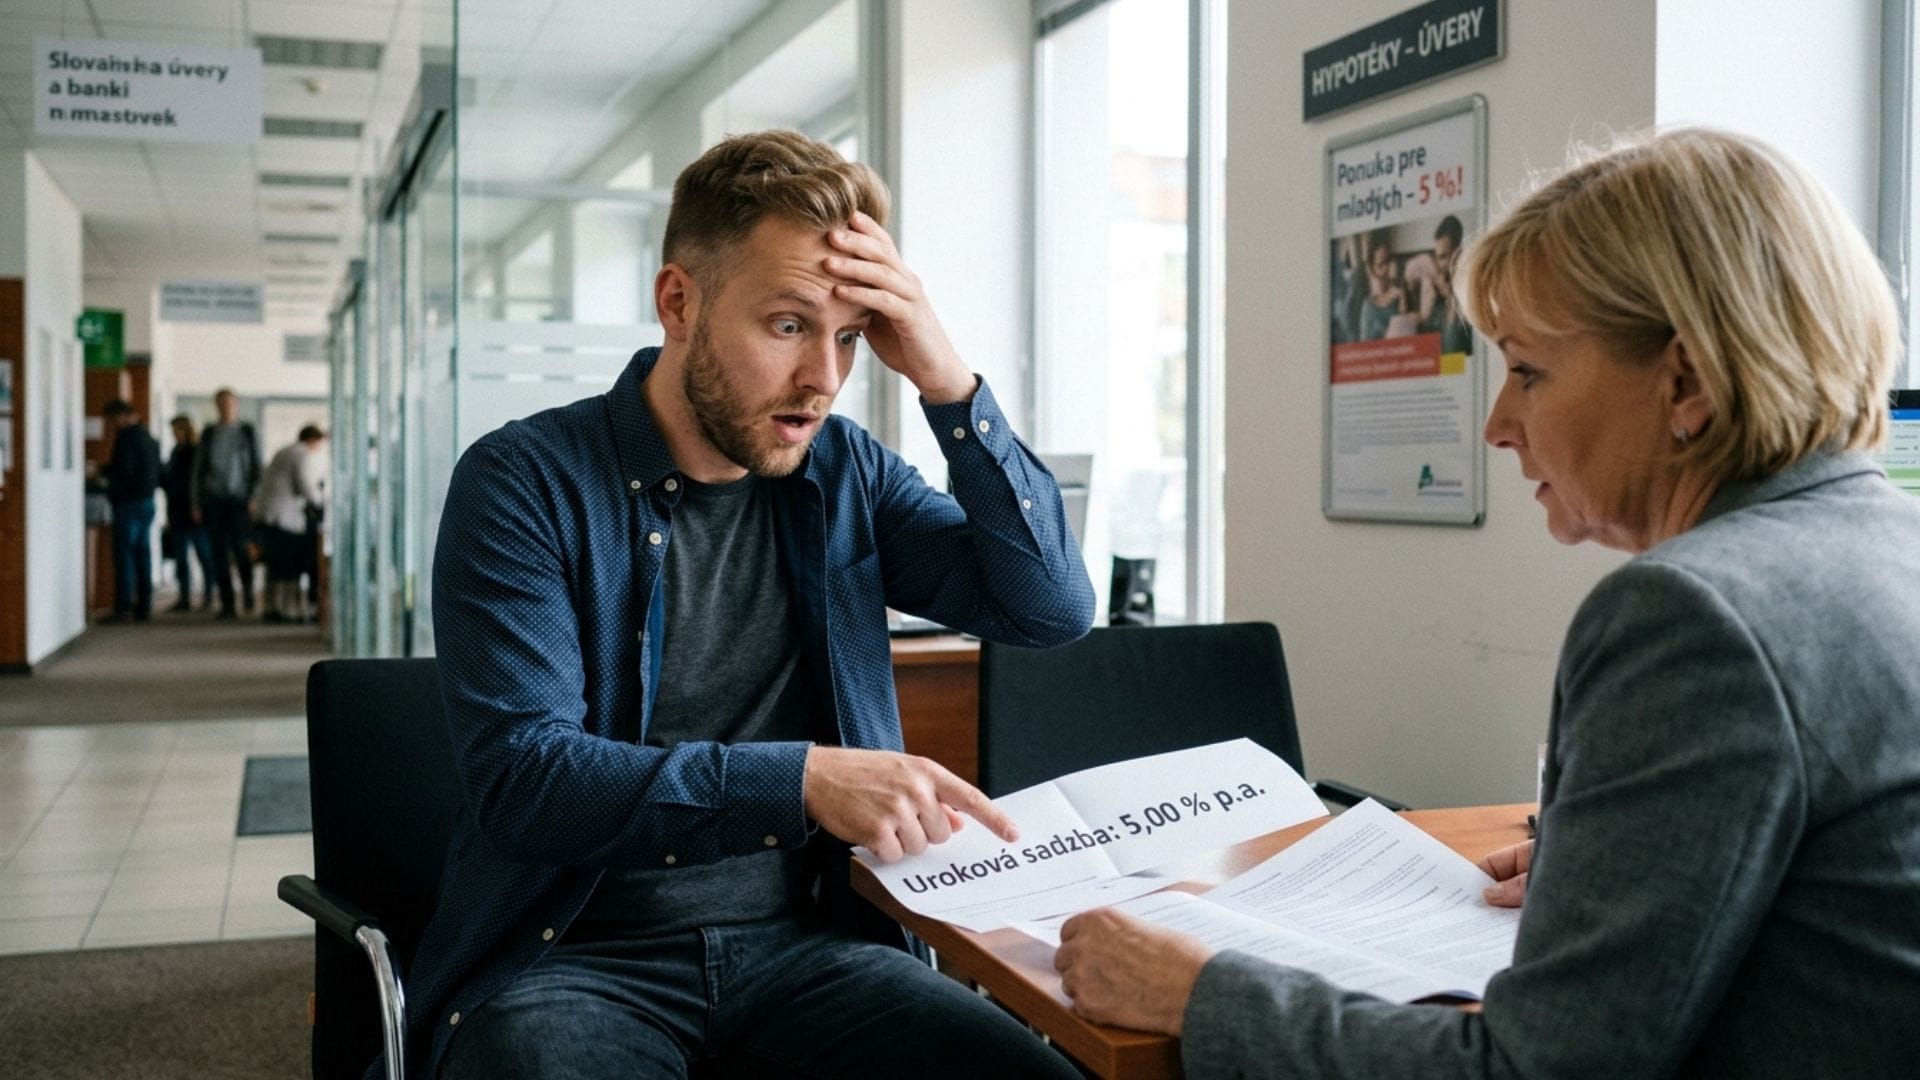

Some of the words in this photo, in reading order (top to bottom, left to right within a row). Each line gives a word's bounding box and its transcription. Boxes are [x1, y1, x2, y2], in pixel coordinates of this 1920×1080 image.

[168, 58, 229, 83] úvery
[1311, 38, 1402, 96] HYPOTÉKY
[1418, 6, 1484, 57] ÚVERY
[49, 81, 61, 95] a
[68, 78, 130, 98] banki
[1337, 151, 1394, 187] Ponuka
[1399, 146, 1426, 177] pre
[1337, 184, 1402, 221] mladých
[1419, 174, 1430, 205] 5
[1435, 166, 1463, 198] %!
[902, 848, 1019, 894] Uroková
[1022, 825, 1121, 864] sadzba:
[1119, 802, 1181, 836] 5,00
[1180, 791, 1212, 817] %
[1213, 780, 1266, 811] p.a.
